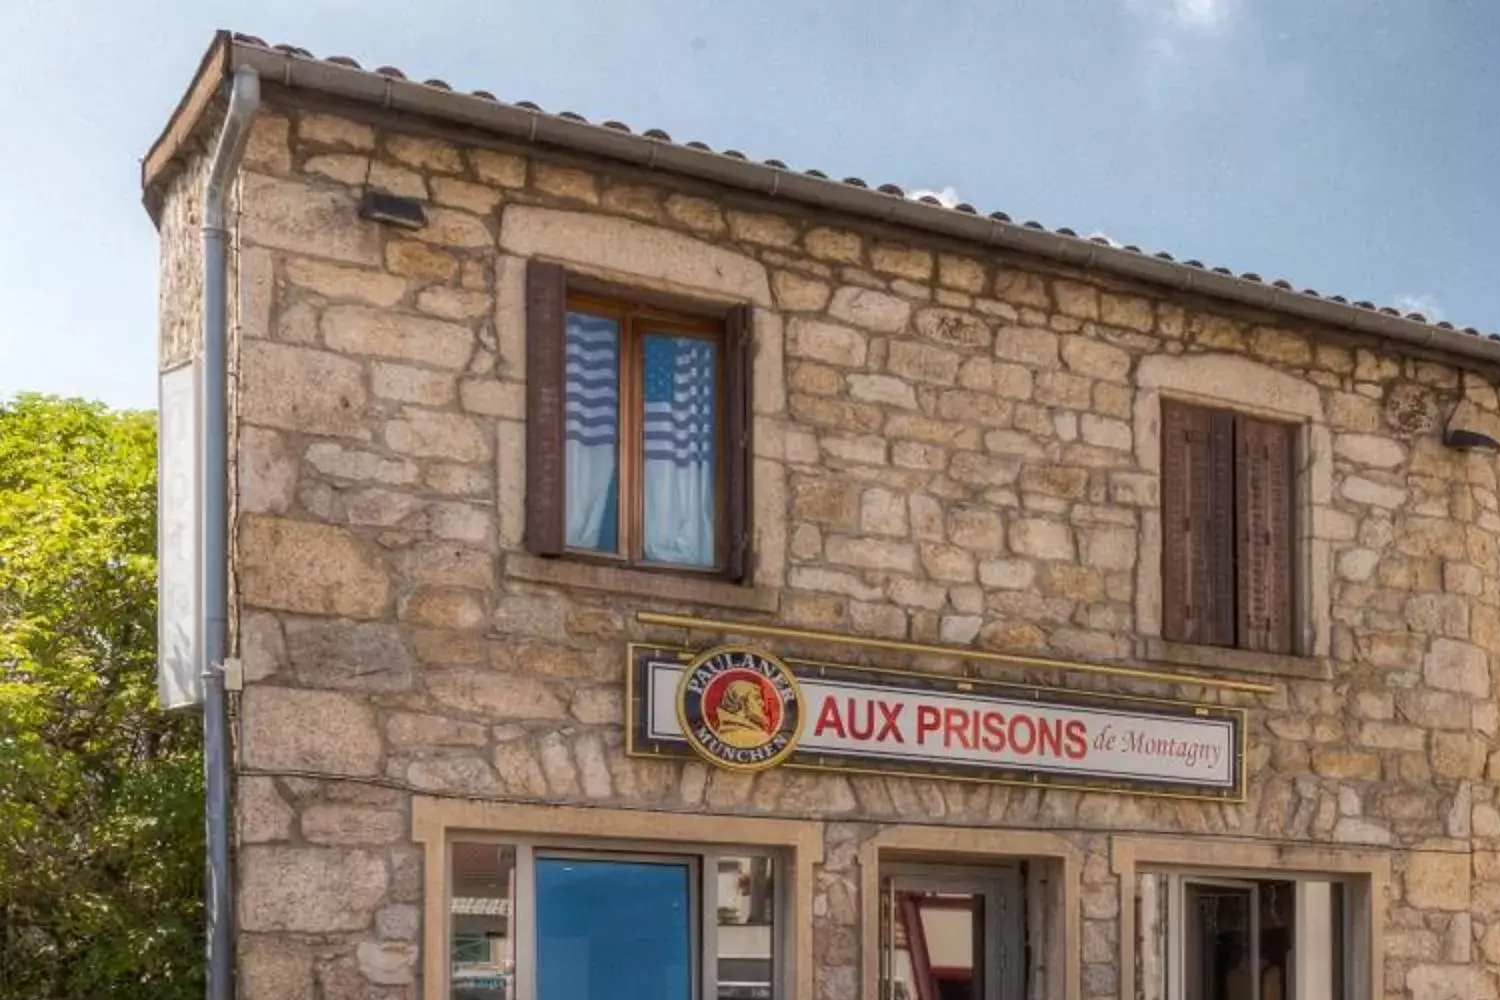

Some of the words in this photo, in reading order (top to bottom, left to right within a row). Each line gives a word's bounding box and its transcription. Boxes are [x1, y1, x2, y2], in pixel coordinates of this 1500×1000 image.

[687, 653, 794, 702] PAULANER
[814, 695, 904, 744] AUX
[917, 705, 1088, 760] PRISONS
[1092, 723, 1116, 751] de
[1121, 728, 1222, 767] Montagny
